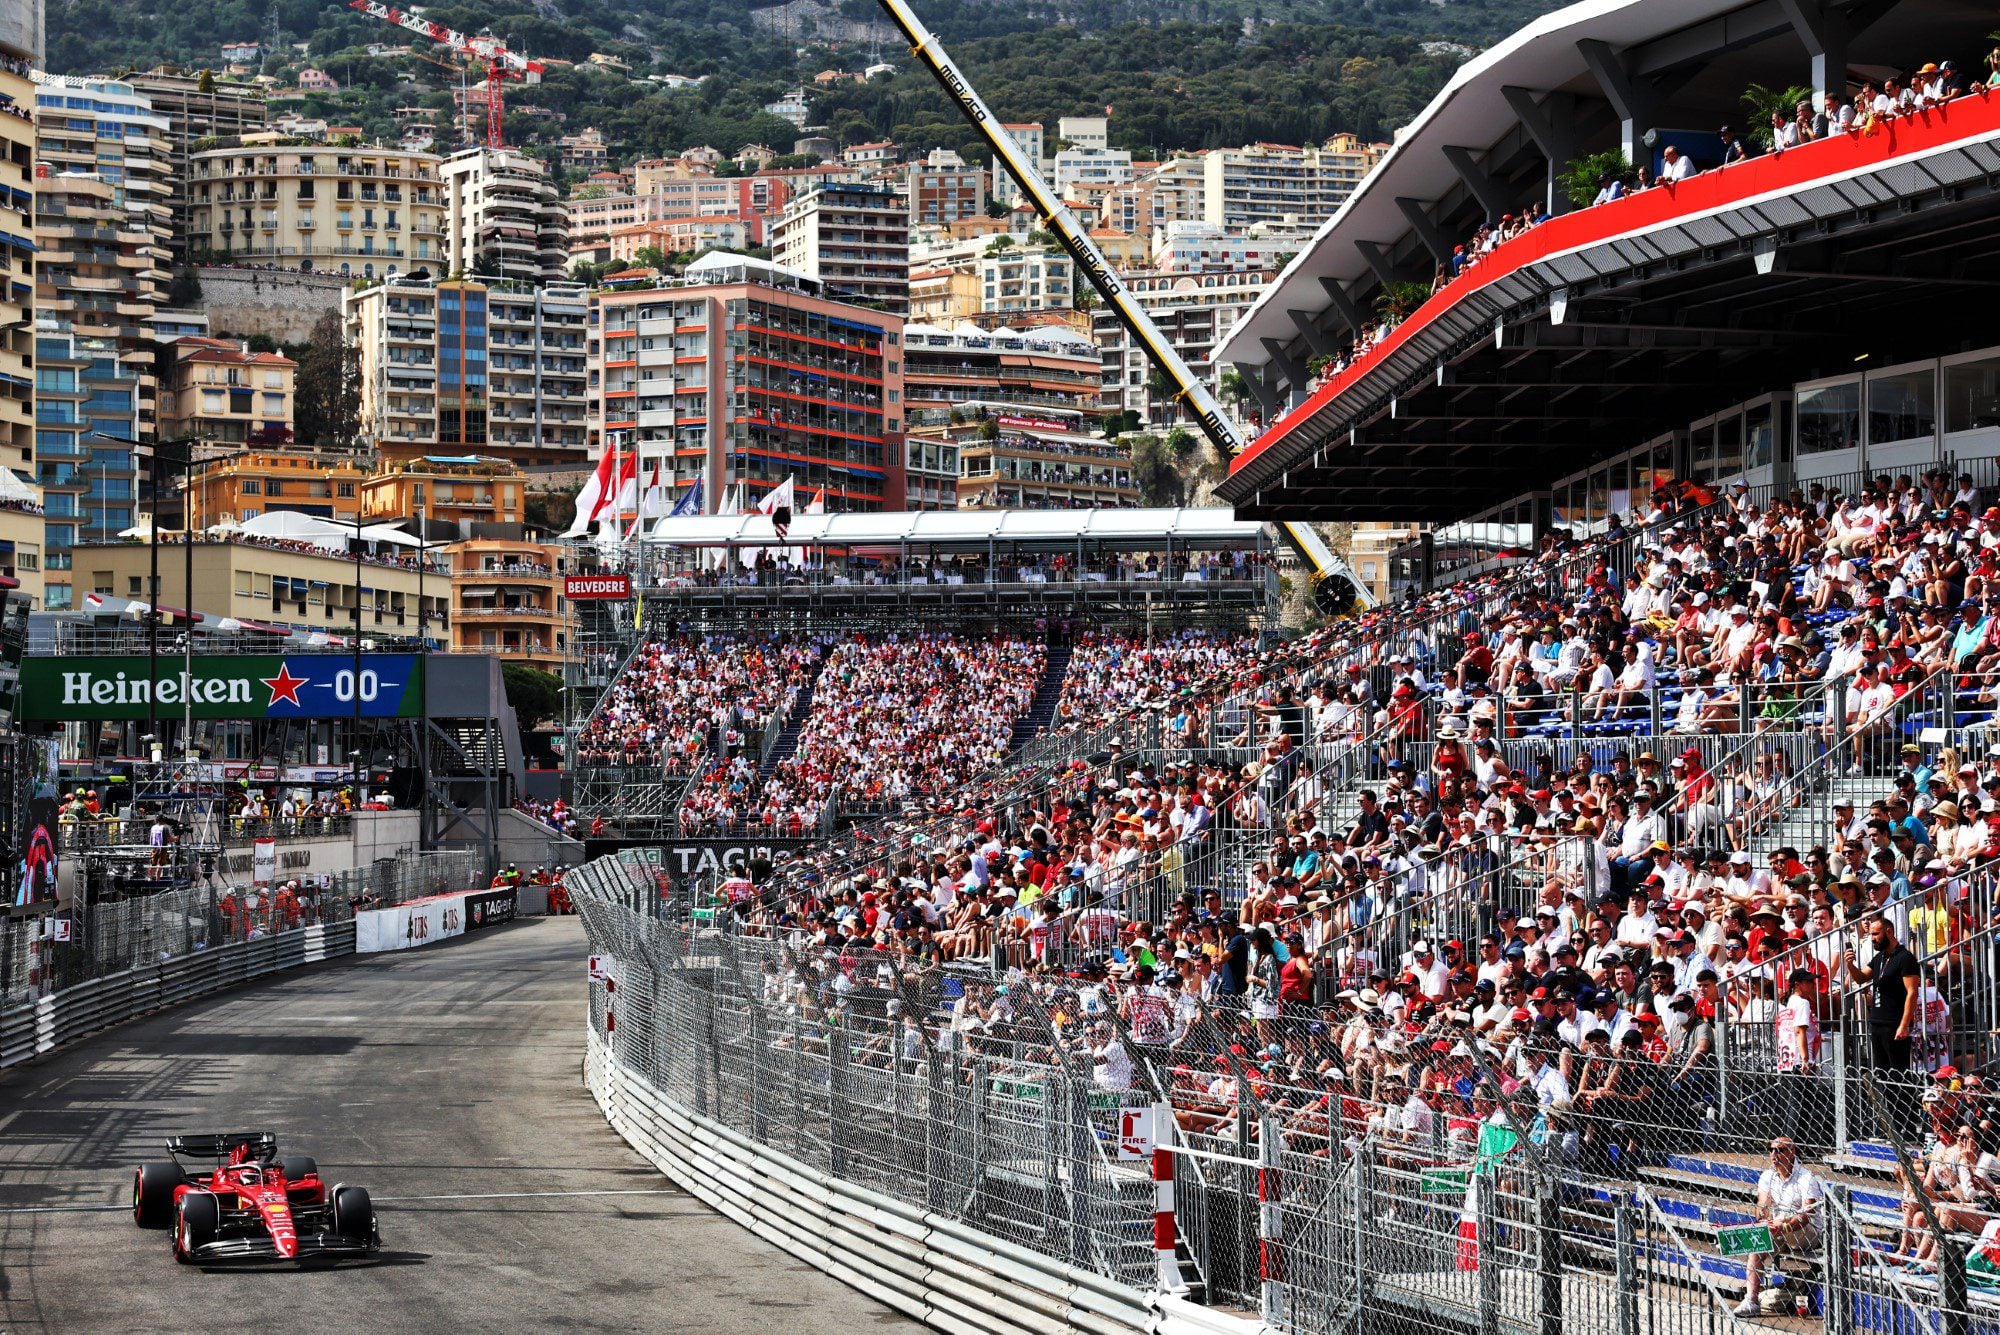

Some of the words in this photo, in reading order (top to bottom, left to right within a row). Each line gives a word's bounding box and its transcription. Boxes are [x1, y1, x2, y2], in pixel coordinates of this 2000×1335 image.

[567, 580, 626, 594] BELVEDERE
[61, 671, 254, 705] Heineken
[335, 668, 379, 702] 00
